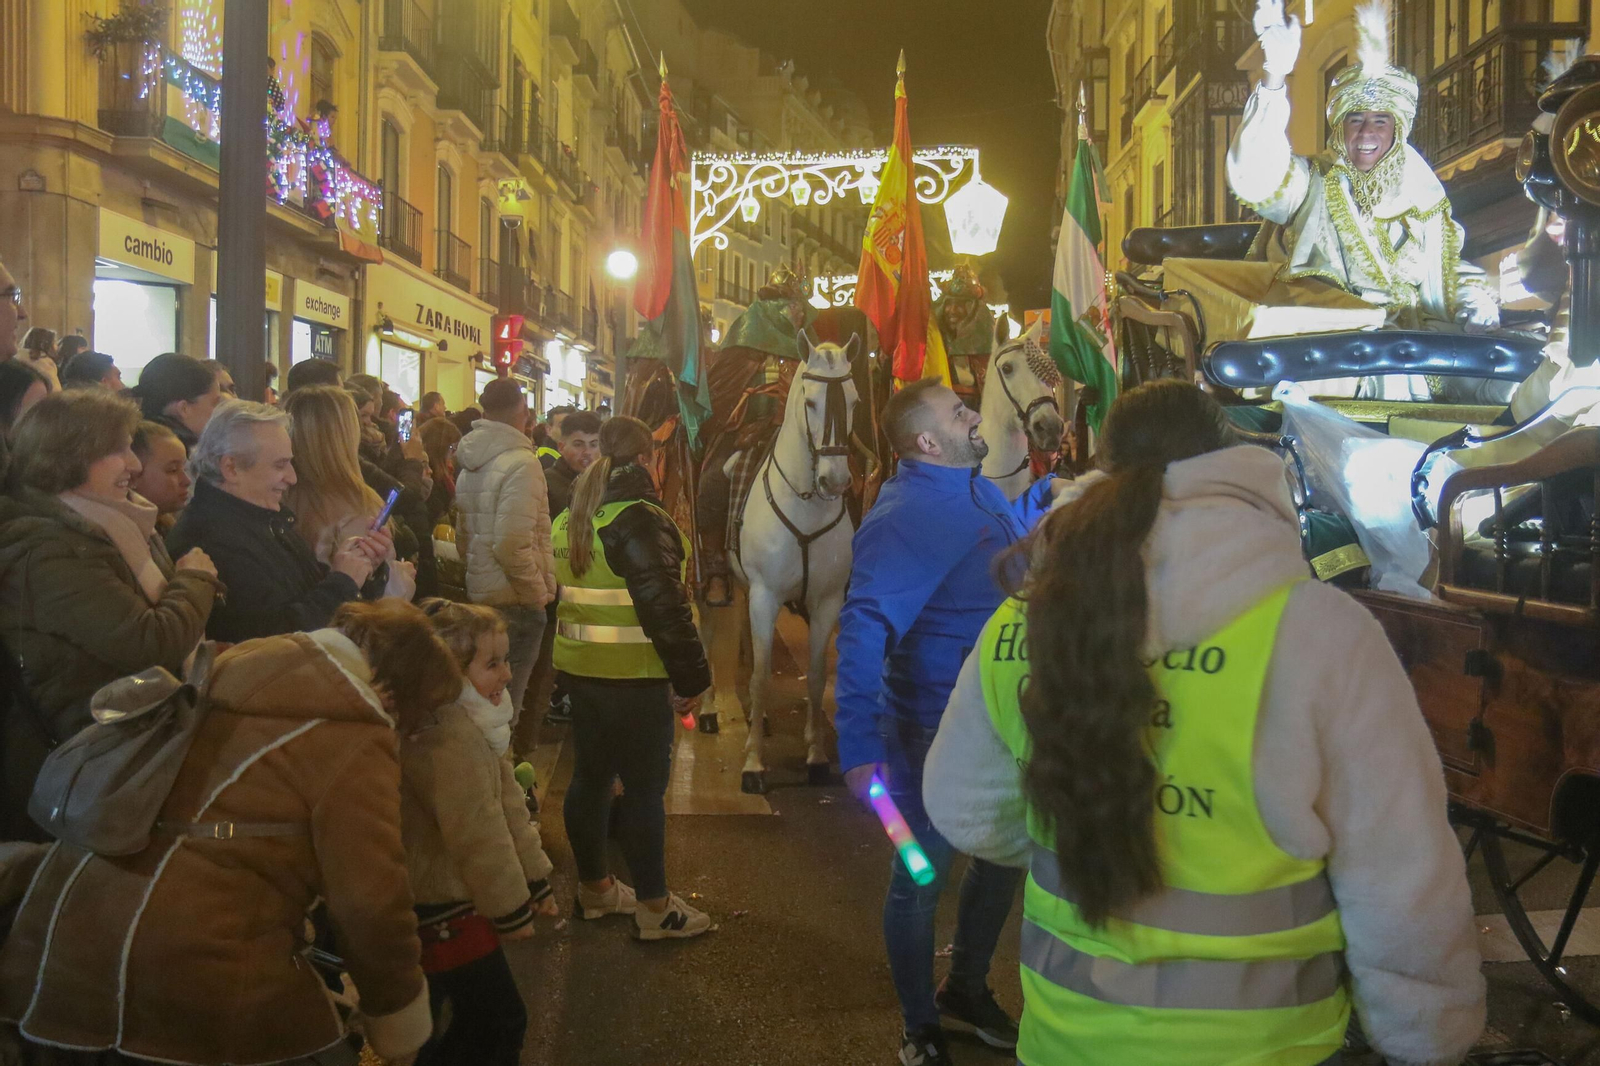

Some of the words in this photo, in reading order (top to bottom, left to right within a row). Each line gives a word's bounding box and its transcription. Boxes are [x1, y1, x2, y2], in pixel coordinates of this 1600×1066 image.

[124, 235, 173, 266] cambio
[305, 296, 341, 320] exchange
[416, 303, 452, 334] ZARA
[314, 334, 333, 355] ATM
